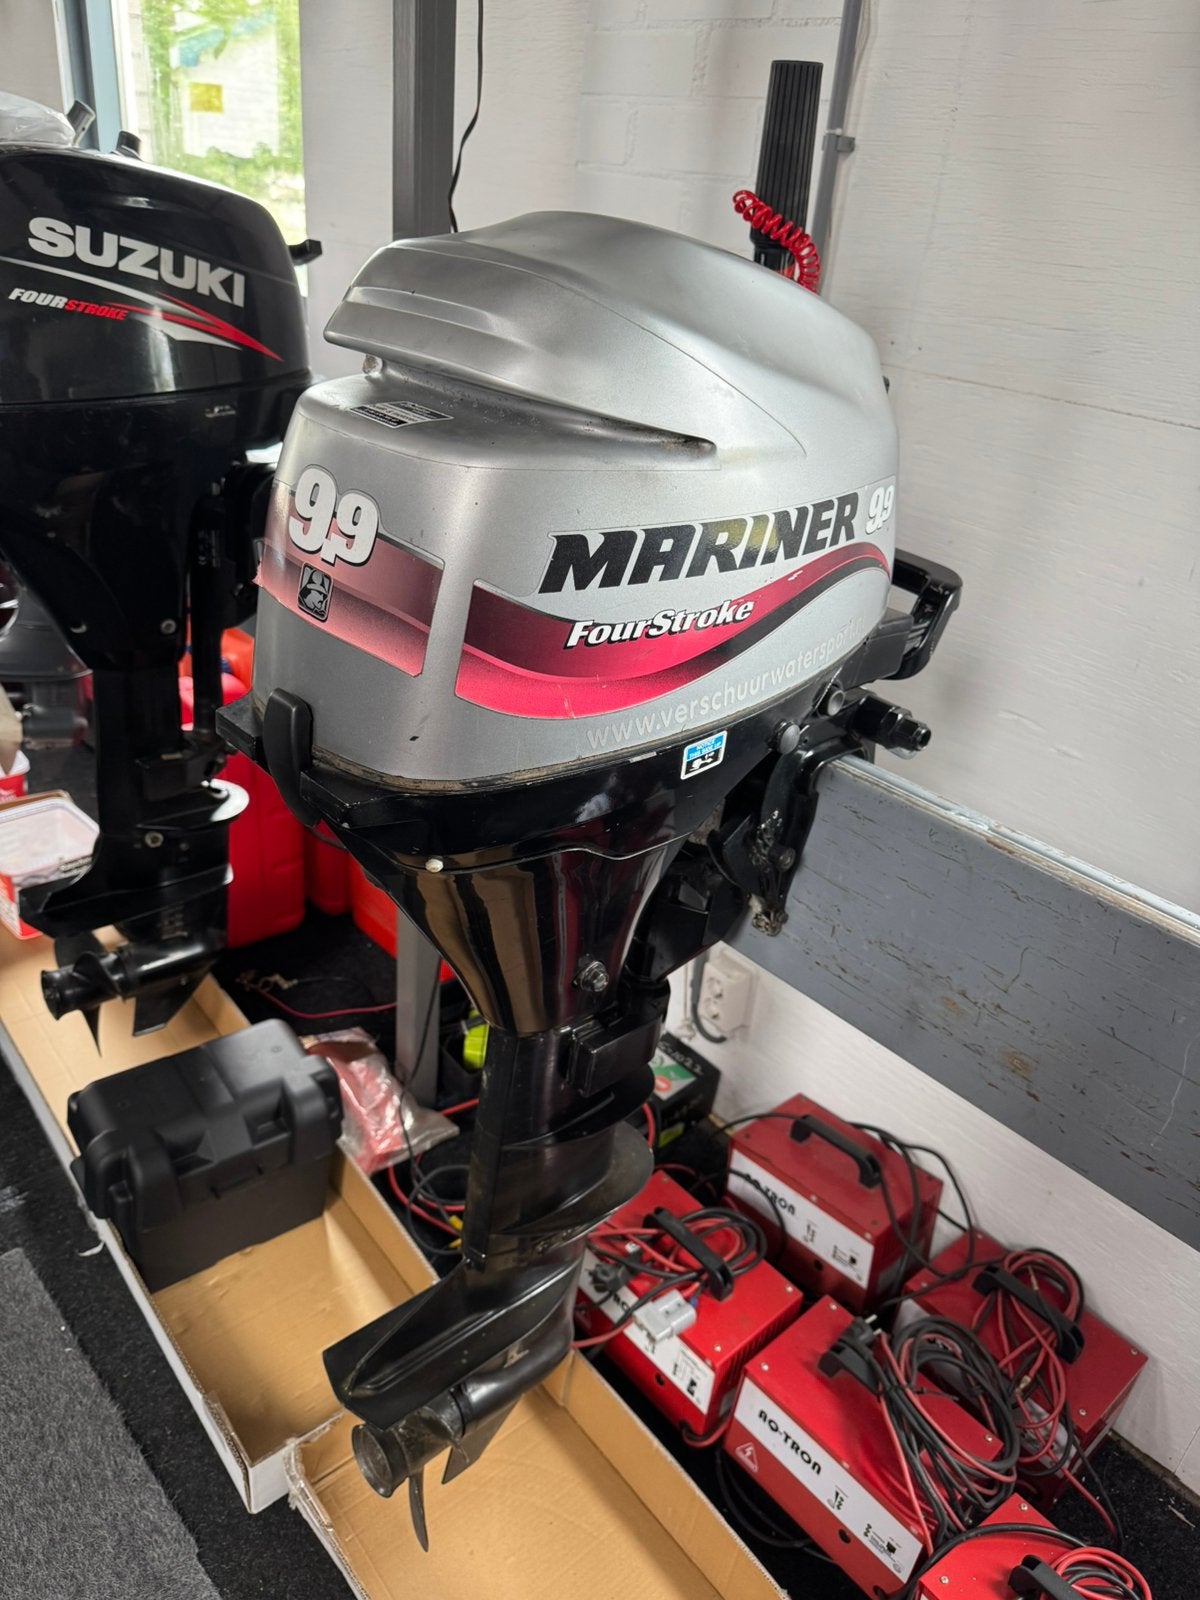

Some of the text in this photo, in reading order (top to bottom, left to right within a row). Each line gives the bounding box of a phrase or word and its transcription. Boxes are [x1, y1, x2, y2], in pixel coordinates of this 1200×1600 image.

[28, 217, 246, 308] SUZUKI
[539, 491, 860, 594] MARINER
[565, 600, 755, 649] FourStroke
[757, 1408, 823, 1477] RO-TRON
